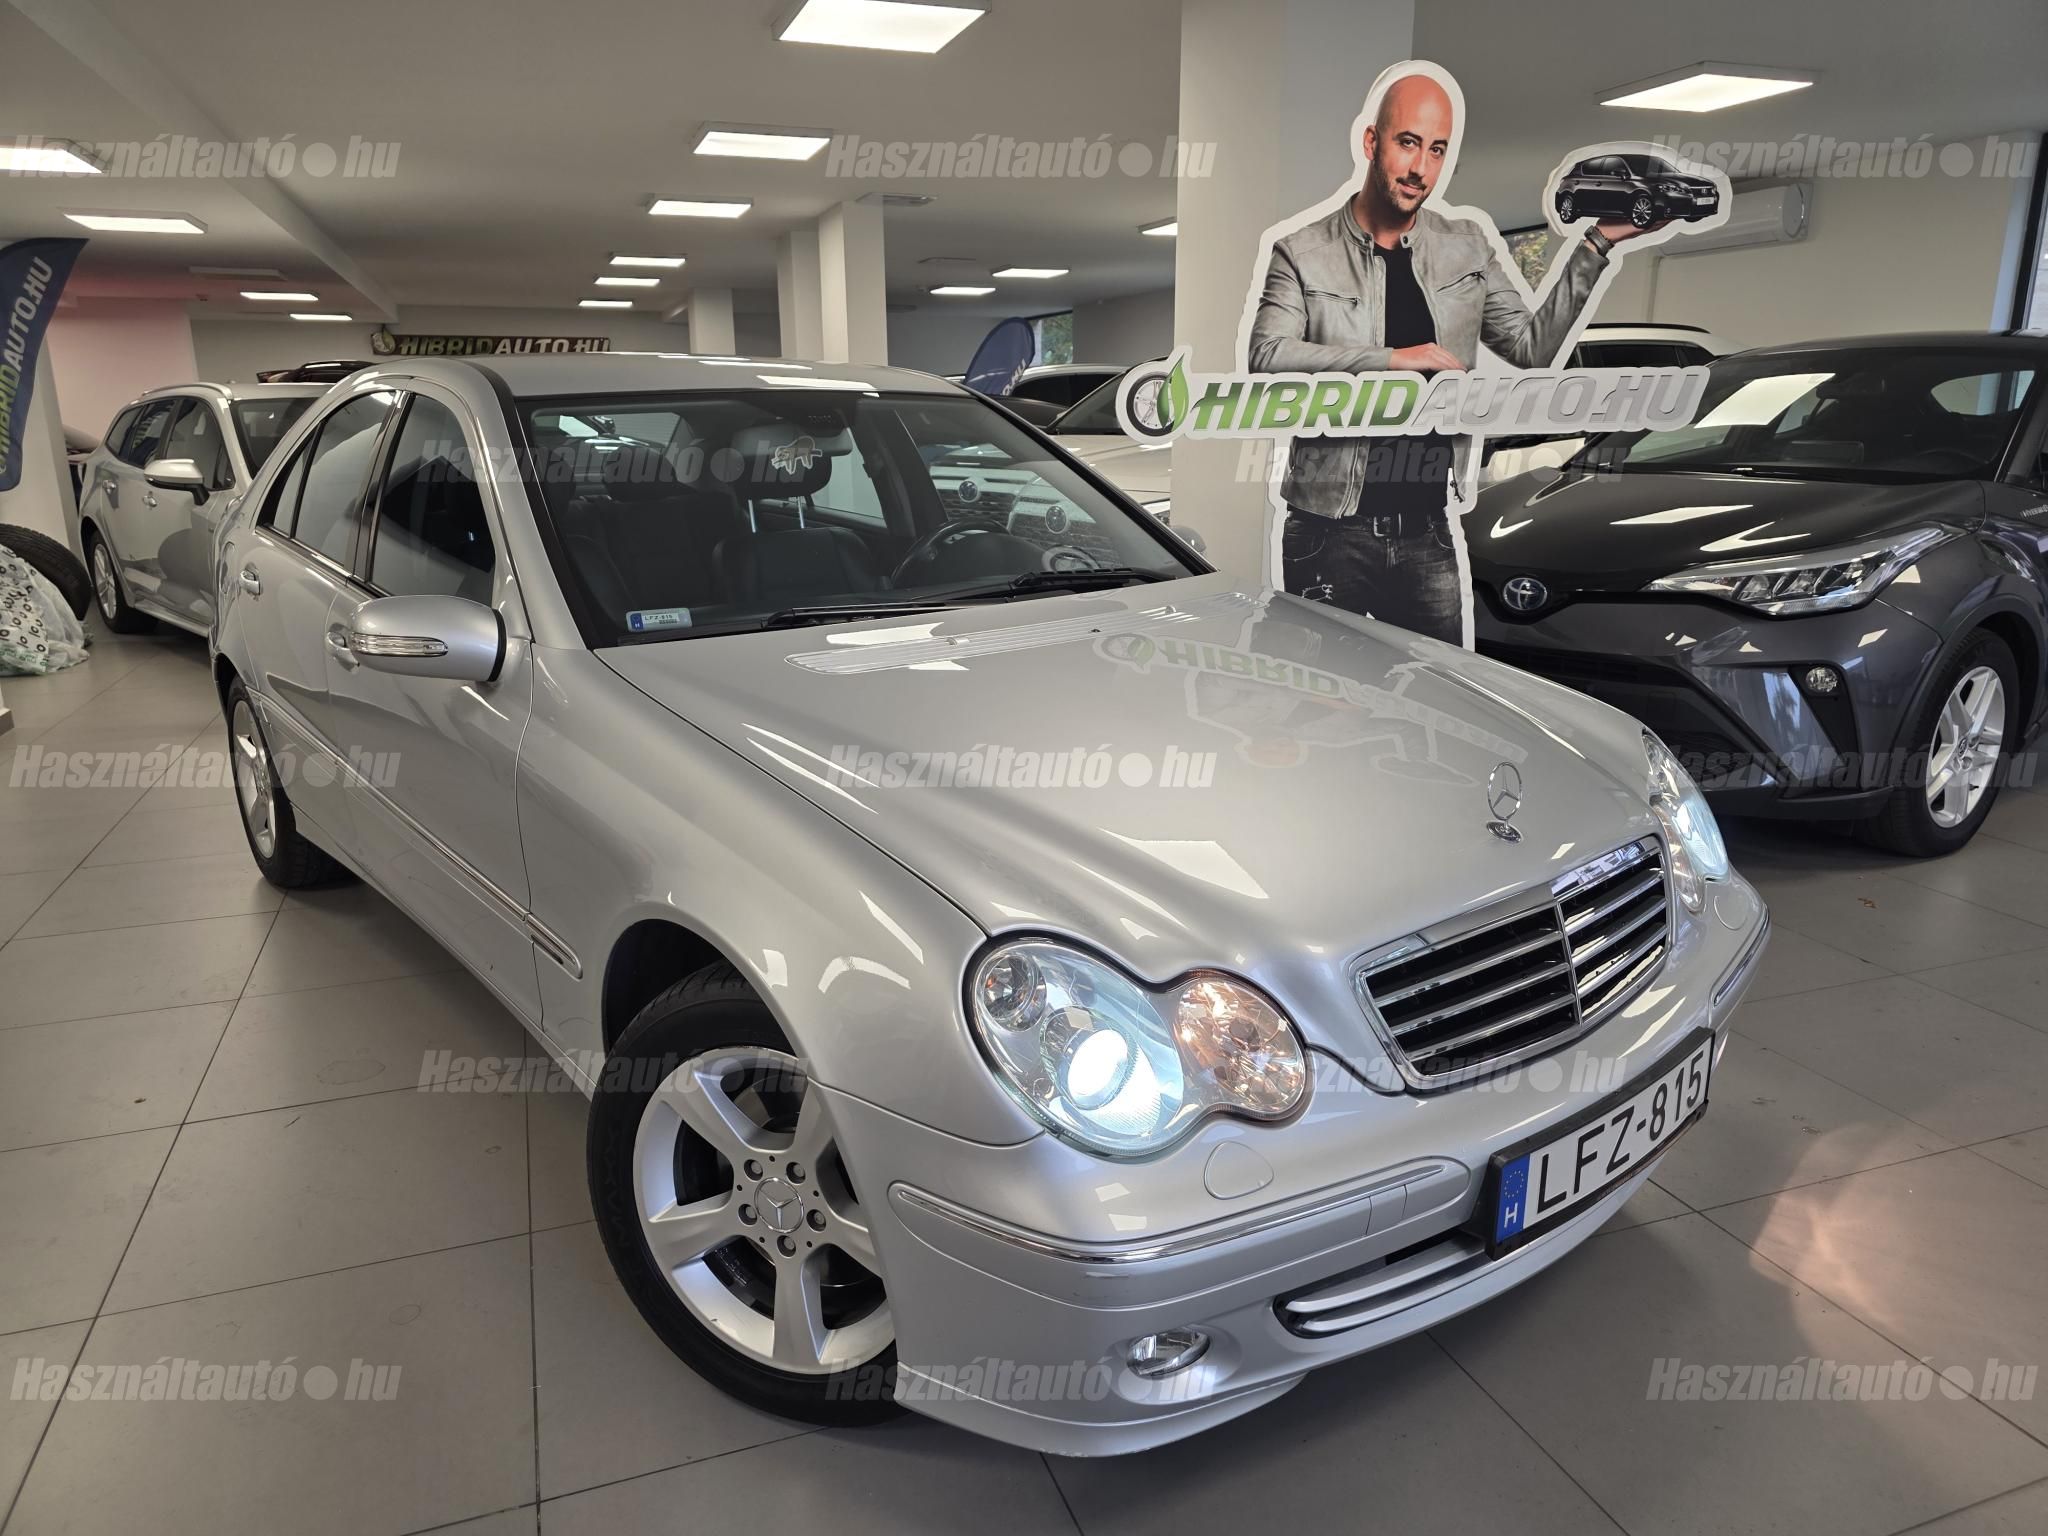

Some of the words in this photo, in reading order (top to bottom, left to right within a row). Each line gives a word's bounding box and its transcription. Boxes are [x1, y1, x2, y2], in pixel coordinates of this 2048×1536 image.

[400, 337, 609, 354] HIBRIDAUTOHU
[1191, 374, 1701, 431] HIBRIDAUTO.HU
[1537, 1050, 1704, 1214] LFZ-815
[1503, 1203, 1519, 1229] H
